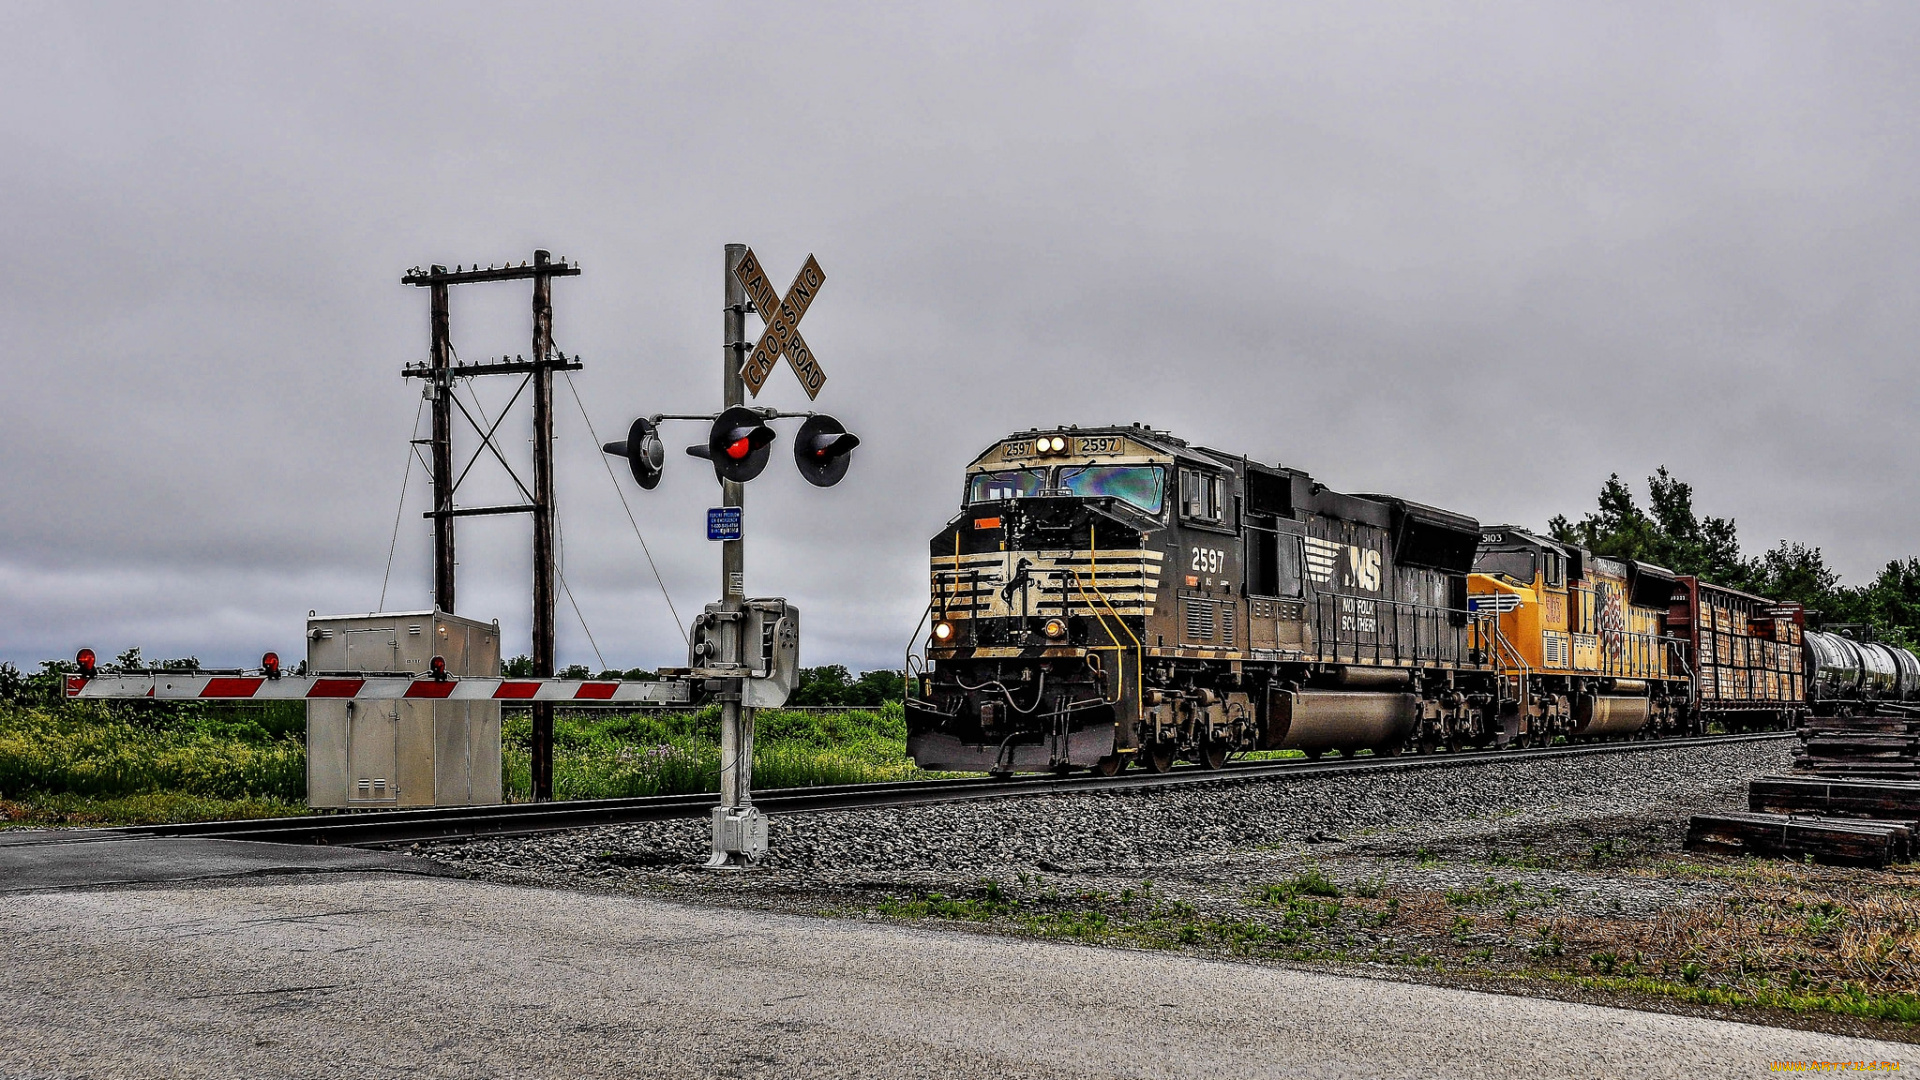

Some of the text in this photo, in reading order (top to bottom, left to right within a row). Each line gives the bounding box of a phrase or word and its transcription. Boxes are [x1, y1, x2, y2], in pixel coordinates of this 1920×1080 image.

[741, 257, 772, 316] RAIL
[748, 268, 818, 385] CROSSING
[788, 335, 821, 390] ROAD
[1006, 442, 1031, 456] 2597
[1082, 437, 1116, 451] 2597
[1482, 533, 1502, 543] 5103
[1191, 546, 1224, 574] 2597
[1344, 544, 1381, 592] NS
